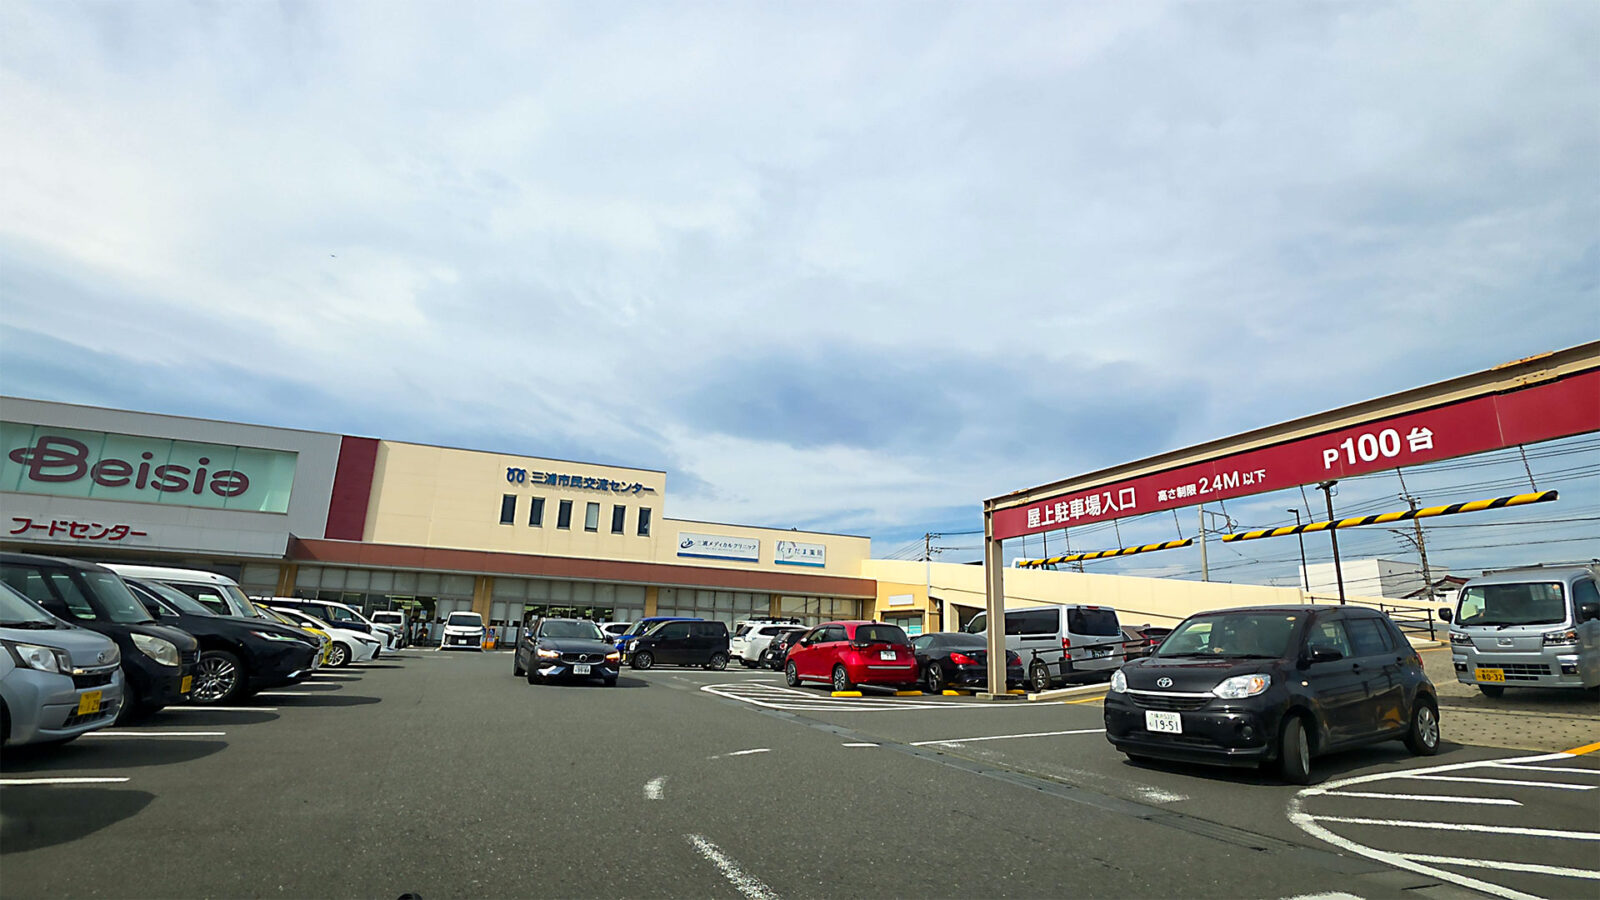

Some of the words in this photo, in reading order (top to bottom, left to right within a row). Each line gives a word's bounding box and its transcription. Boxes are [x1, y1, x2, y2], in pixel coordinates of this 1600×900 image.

[9, 436, 249, 497] Beisia
[530, 471, 655, 494] 三浦市民交流センター
[1027, 487, 1137, 529] 屋上駐車場入口
[10, 517, 147, 541] フードセンター
